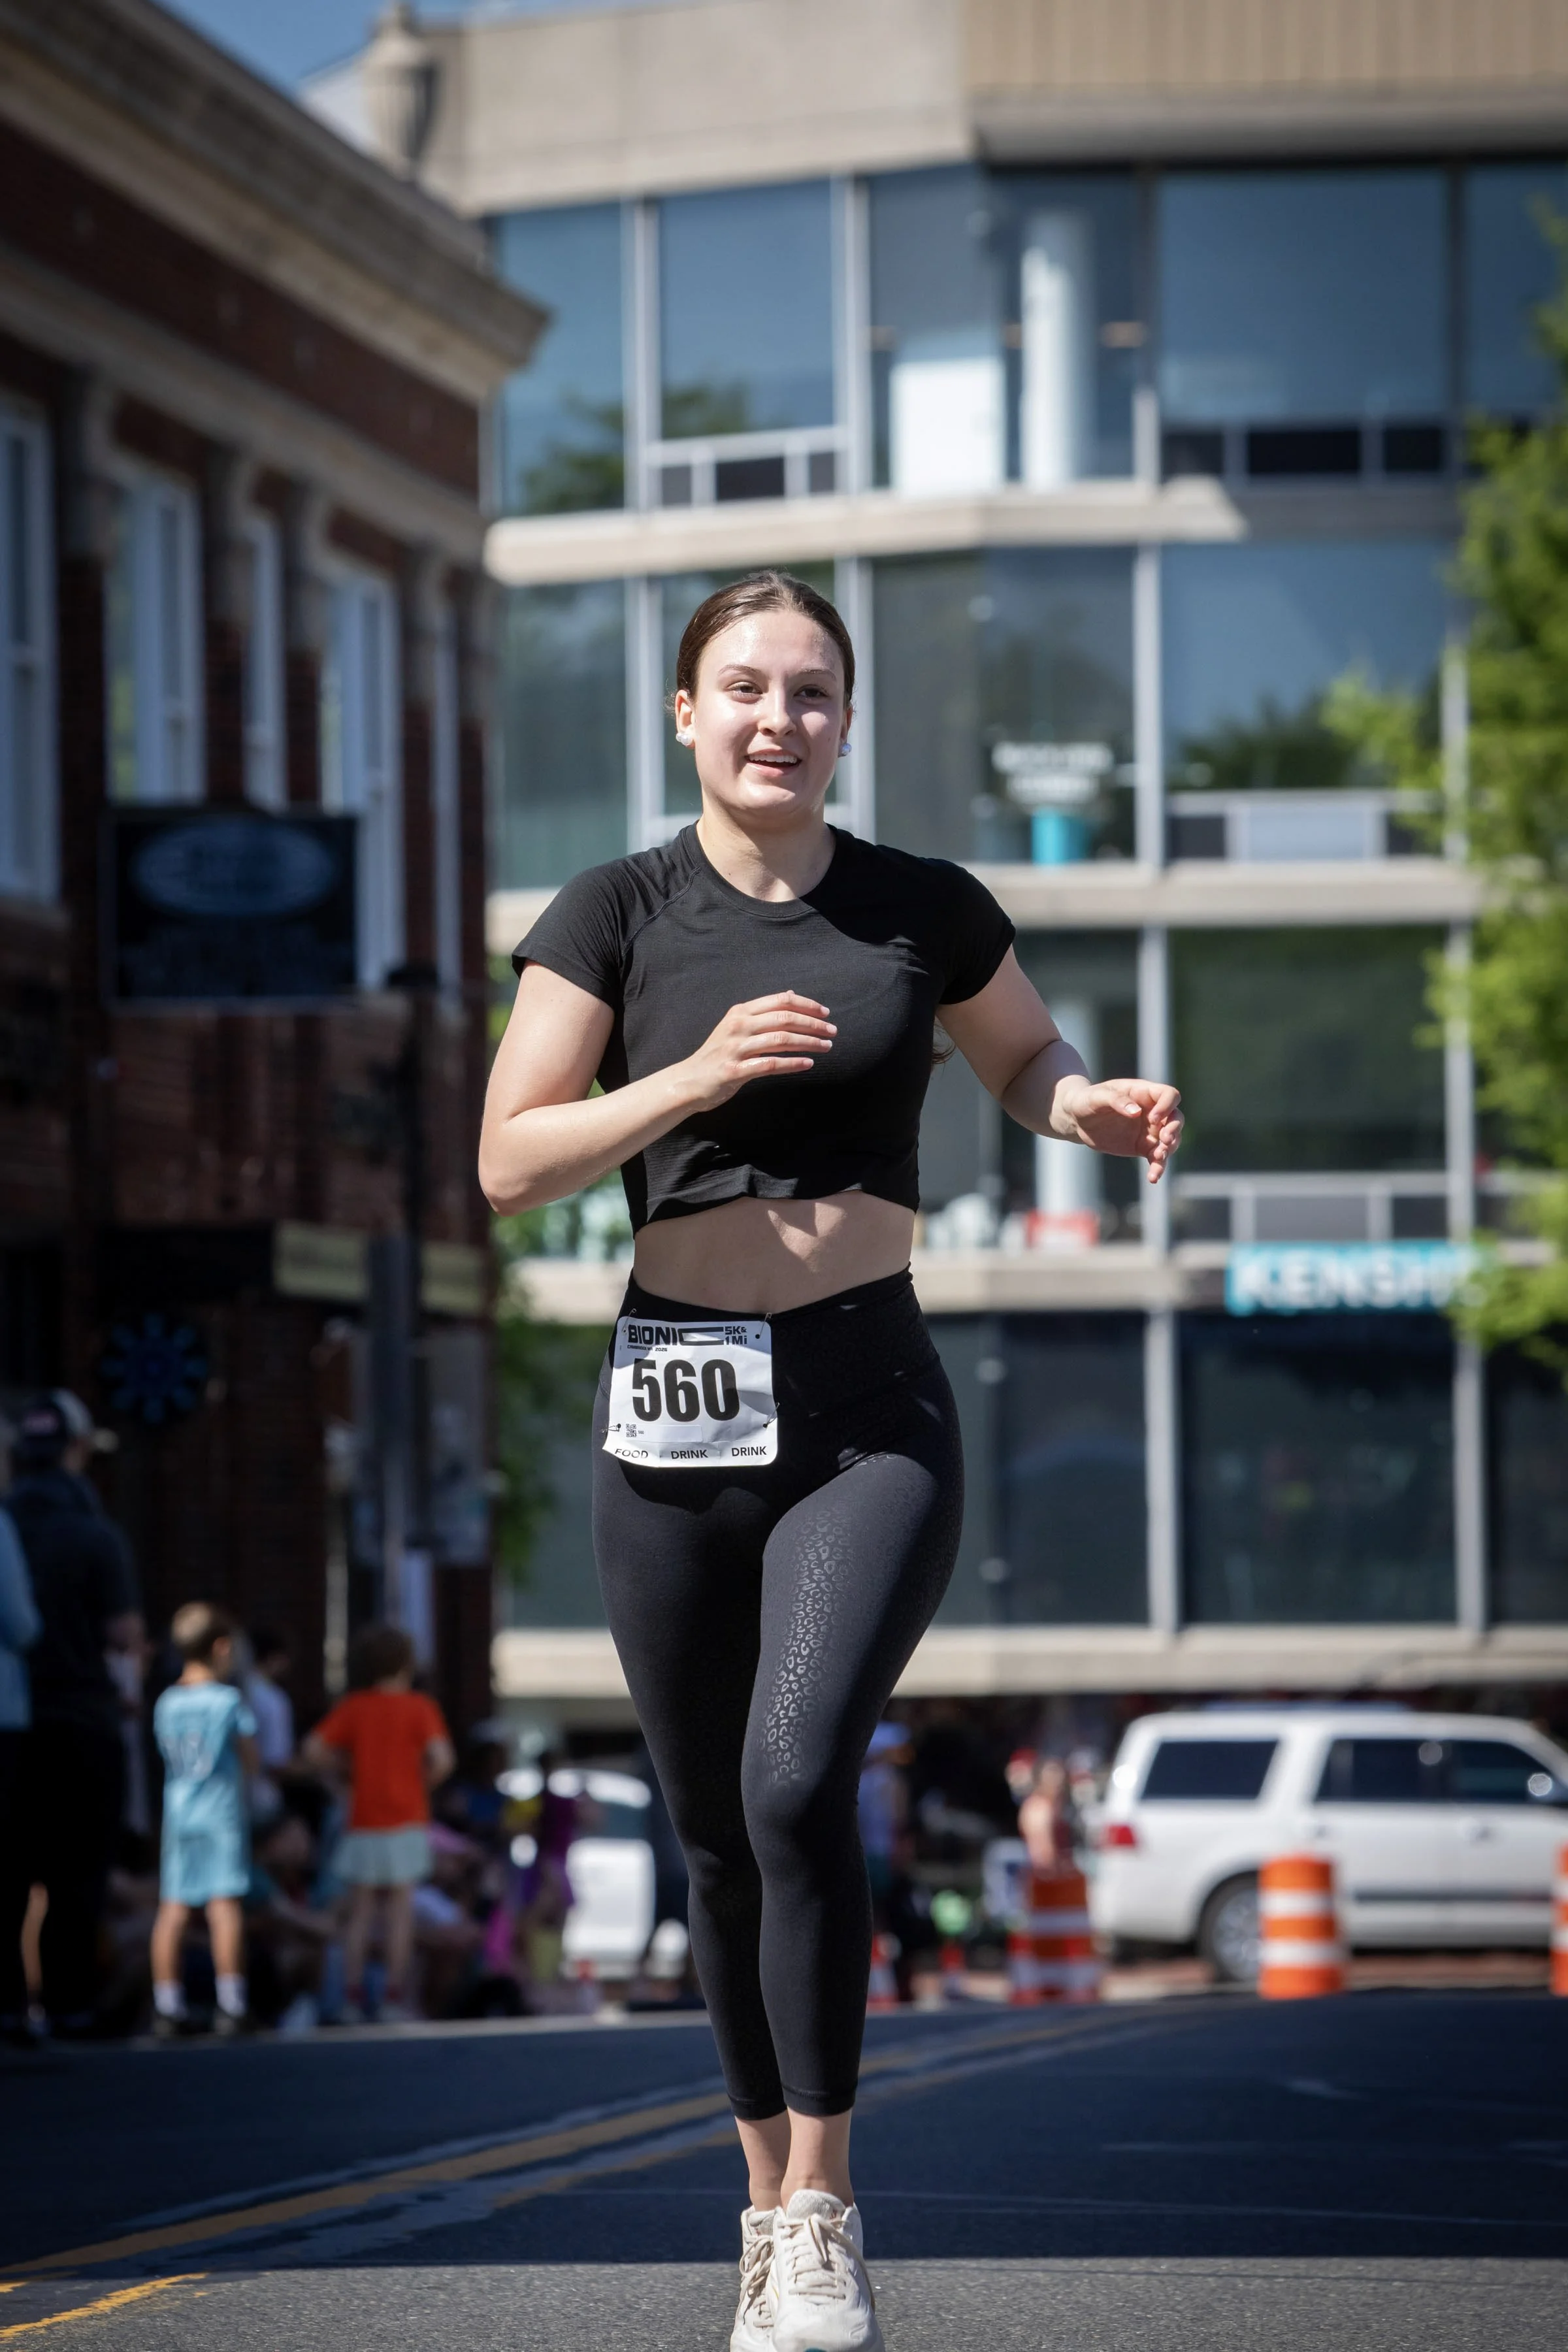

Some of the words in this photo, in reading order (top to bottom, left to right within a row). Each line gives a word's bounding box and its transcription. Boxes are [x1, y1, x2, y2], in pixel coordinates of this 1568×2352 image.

[1232, 1247, 1484, 1309] KENSH
[628, 1324, 724, 1346] BIONIC
[632, 1358, 740, 1422] 560
[614, 1448, 649, 1459] FOOD
[670, 1449, 709, 1460] DRINK
[731, 1446, 767, 1457] DRINK
